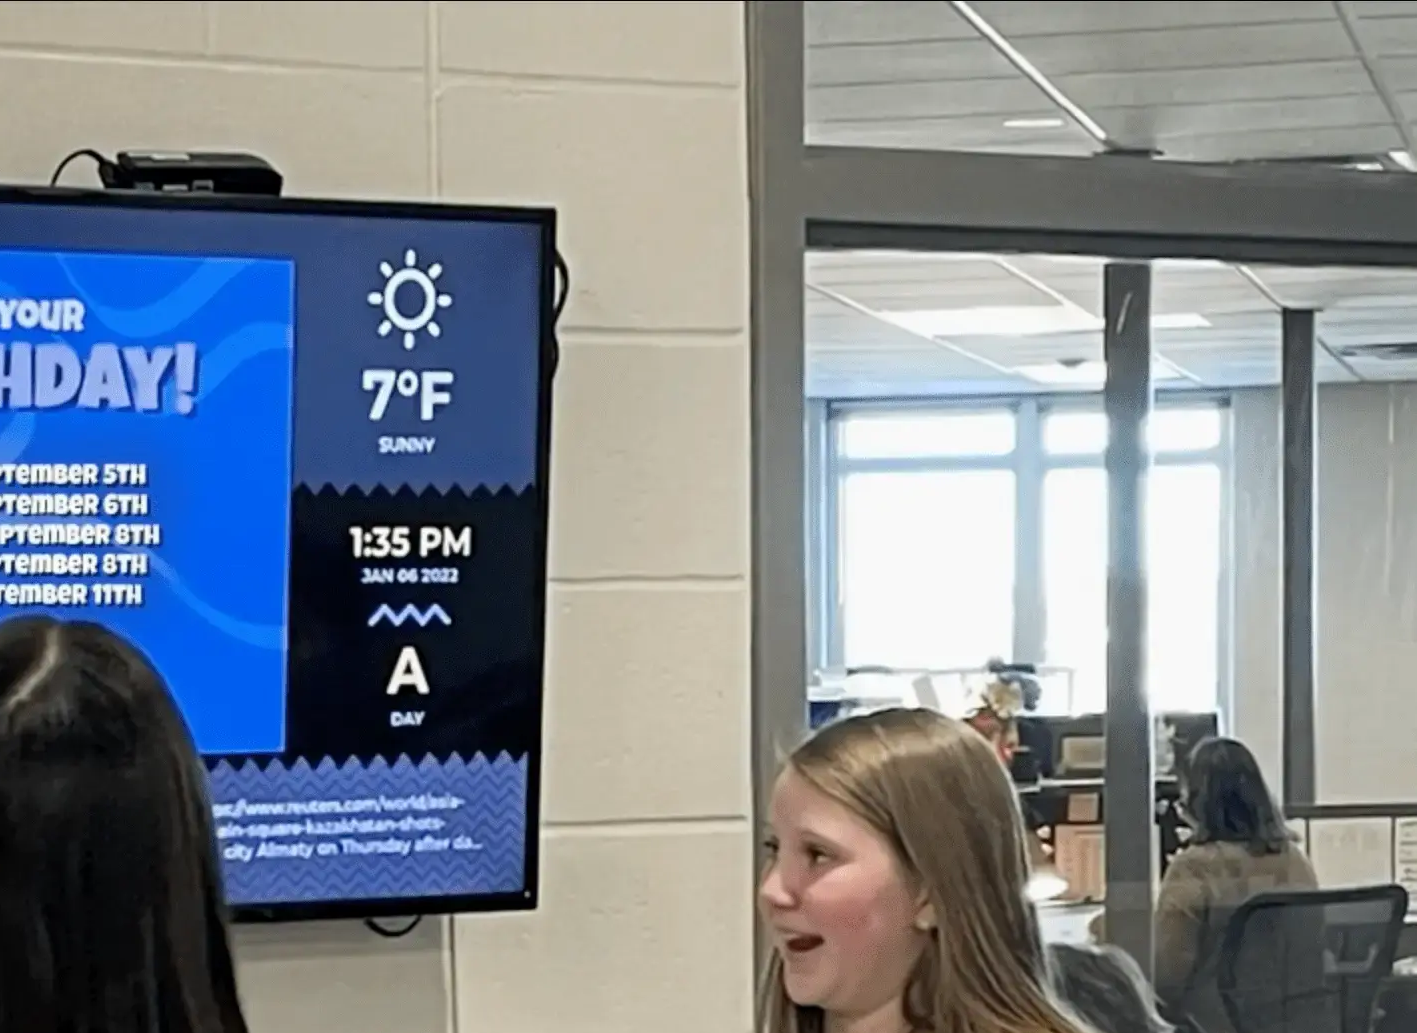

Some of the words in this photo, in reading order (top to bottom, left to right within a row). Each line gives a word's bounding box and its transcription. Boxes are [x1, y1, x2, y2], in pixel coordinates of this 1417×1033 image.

[378, 436, 435, 453] SUNNY
[102, 463, 146, 485] 5TH
[103, 493, 148, 515] 6TH
[349, 526, 411, 558] 1:35
[419, 526, 472, 557] PM
[361, 567, 394, 584] JAN
[396, 568, 419, 583] 06
[421, 567, 459, 583] 2022
[92, 583, 142, 604] 11TH
[386, 646, 430, 695] A
[390, 711, 425, 727] DAY
